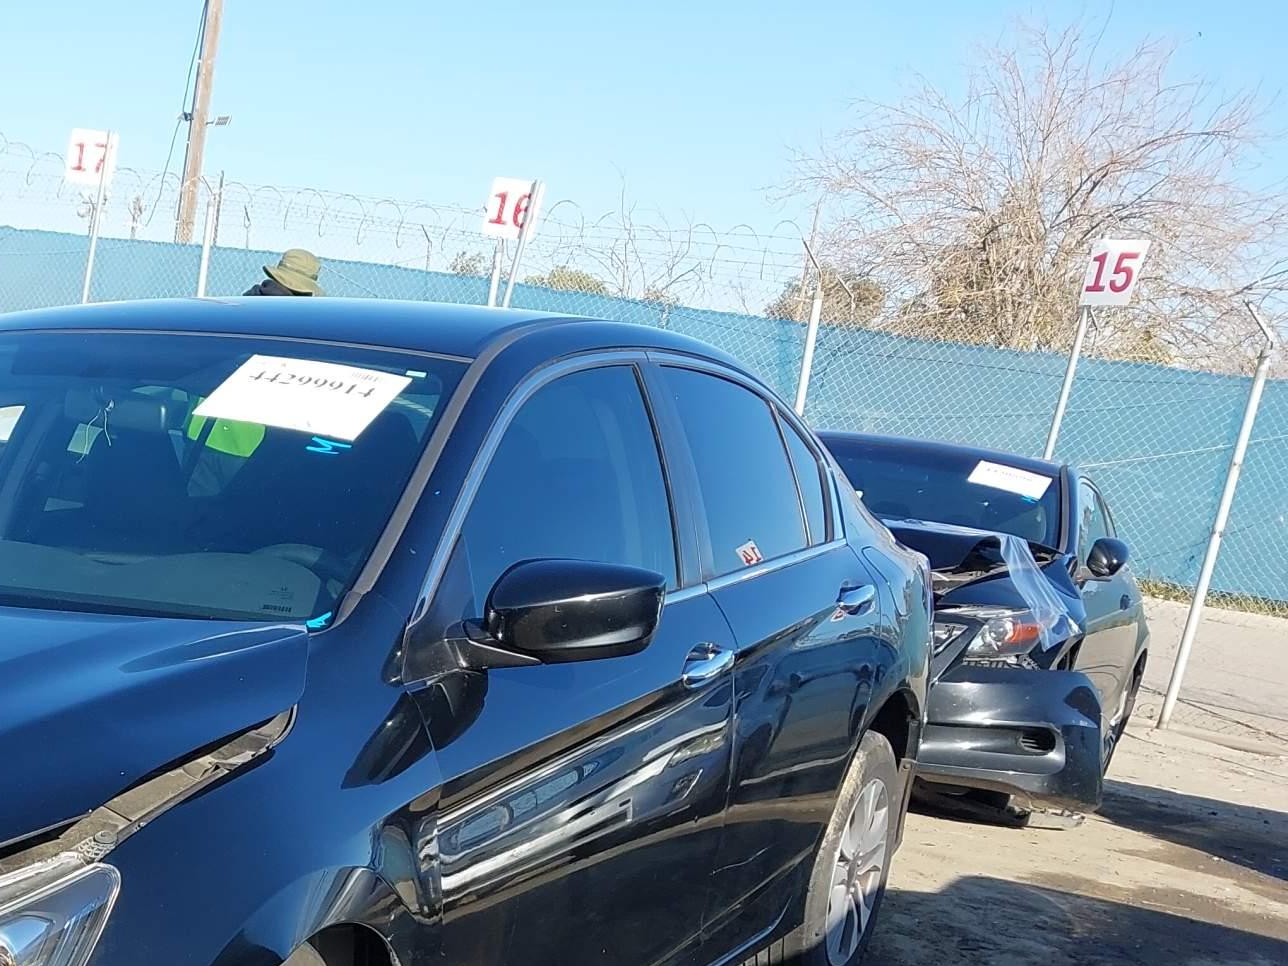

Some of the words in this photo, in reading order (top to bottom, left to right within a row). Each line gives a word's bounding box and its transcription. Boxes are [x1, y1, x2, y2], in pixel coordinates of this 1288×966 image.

[71, 141, 112, 174] 17
[487, 190, 532, 229] 16
[1084, 251, 1140, 293] 15
[248, 370, 376, 398] 44299914
